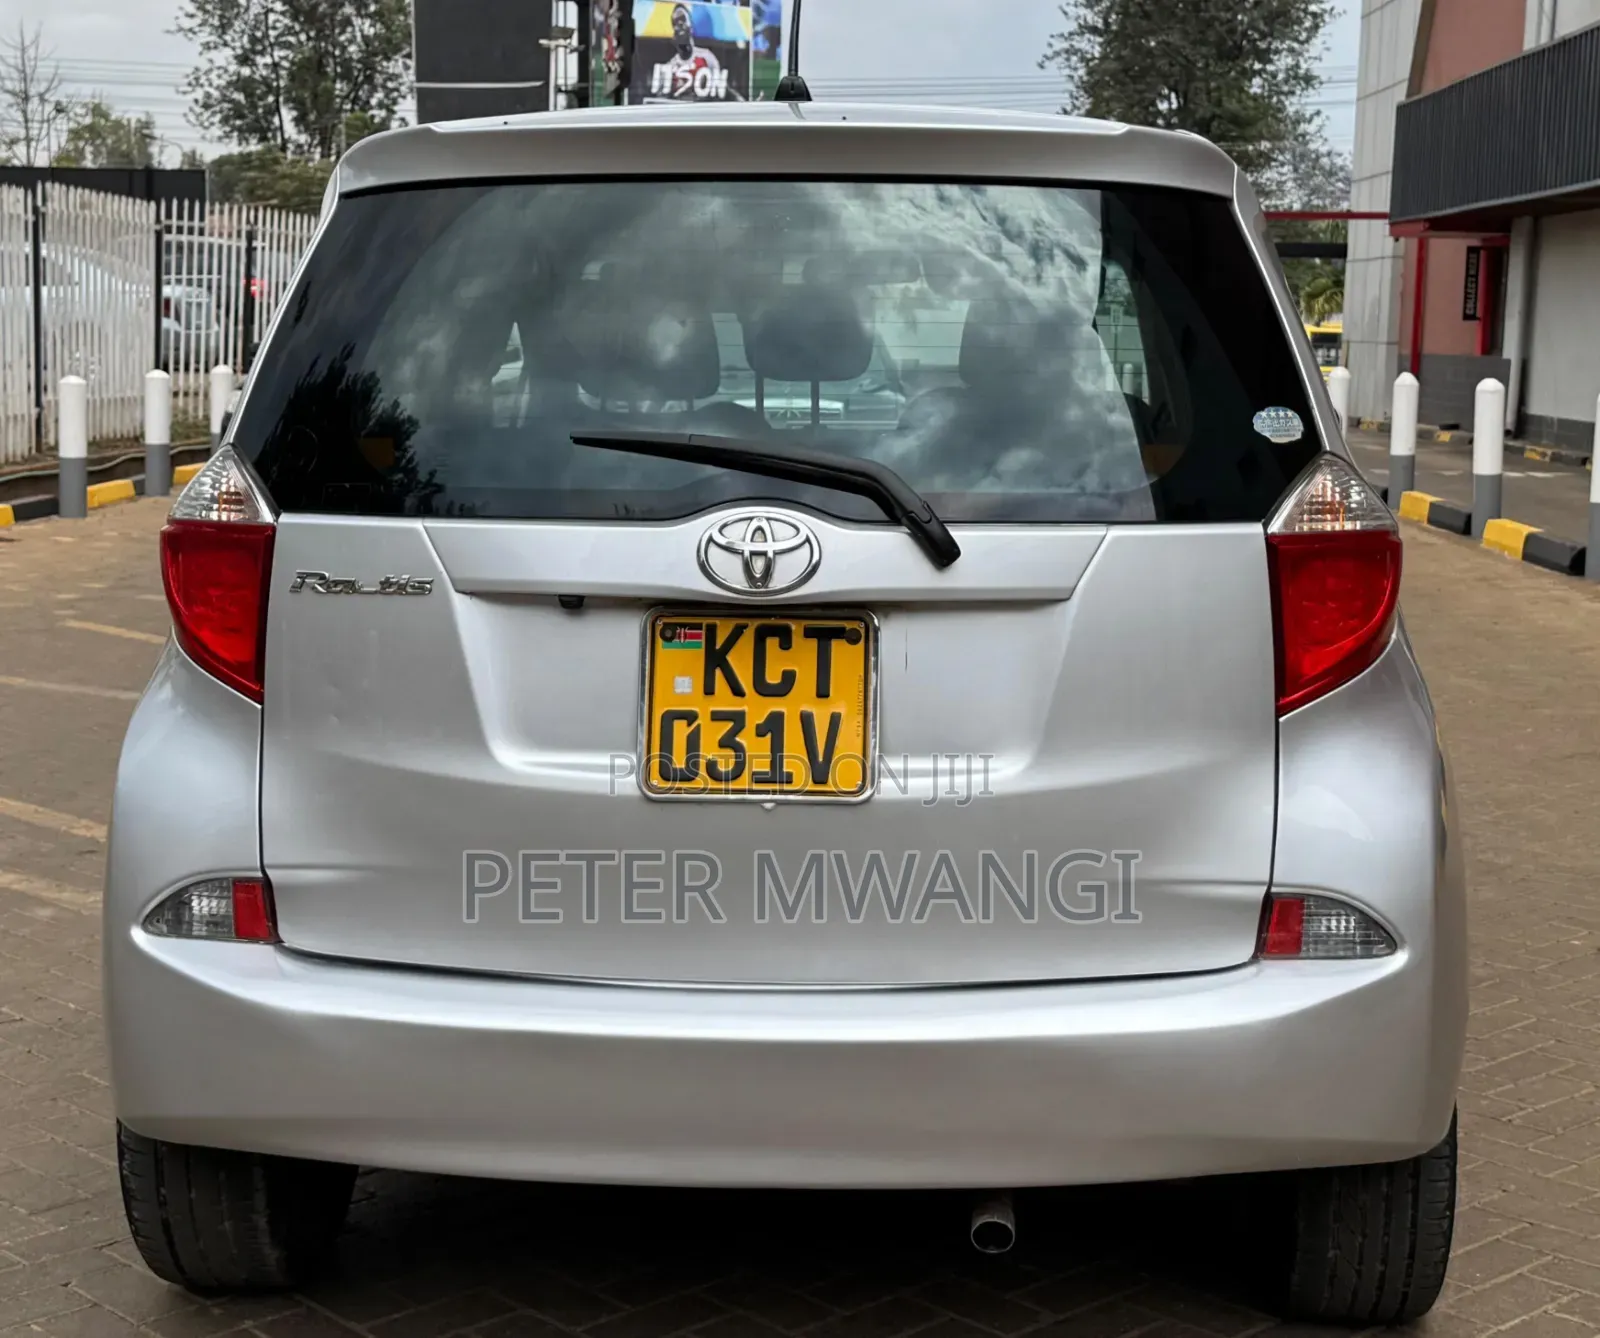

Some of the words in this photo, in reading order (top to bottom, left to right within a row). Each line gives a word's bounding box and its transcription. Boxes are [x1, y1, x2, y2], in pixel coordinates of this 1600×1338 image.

[694, 67, 729, 98] ON
[703, 622, 847, 698] KCT
[658, 708, 843, 785] 031V
